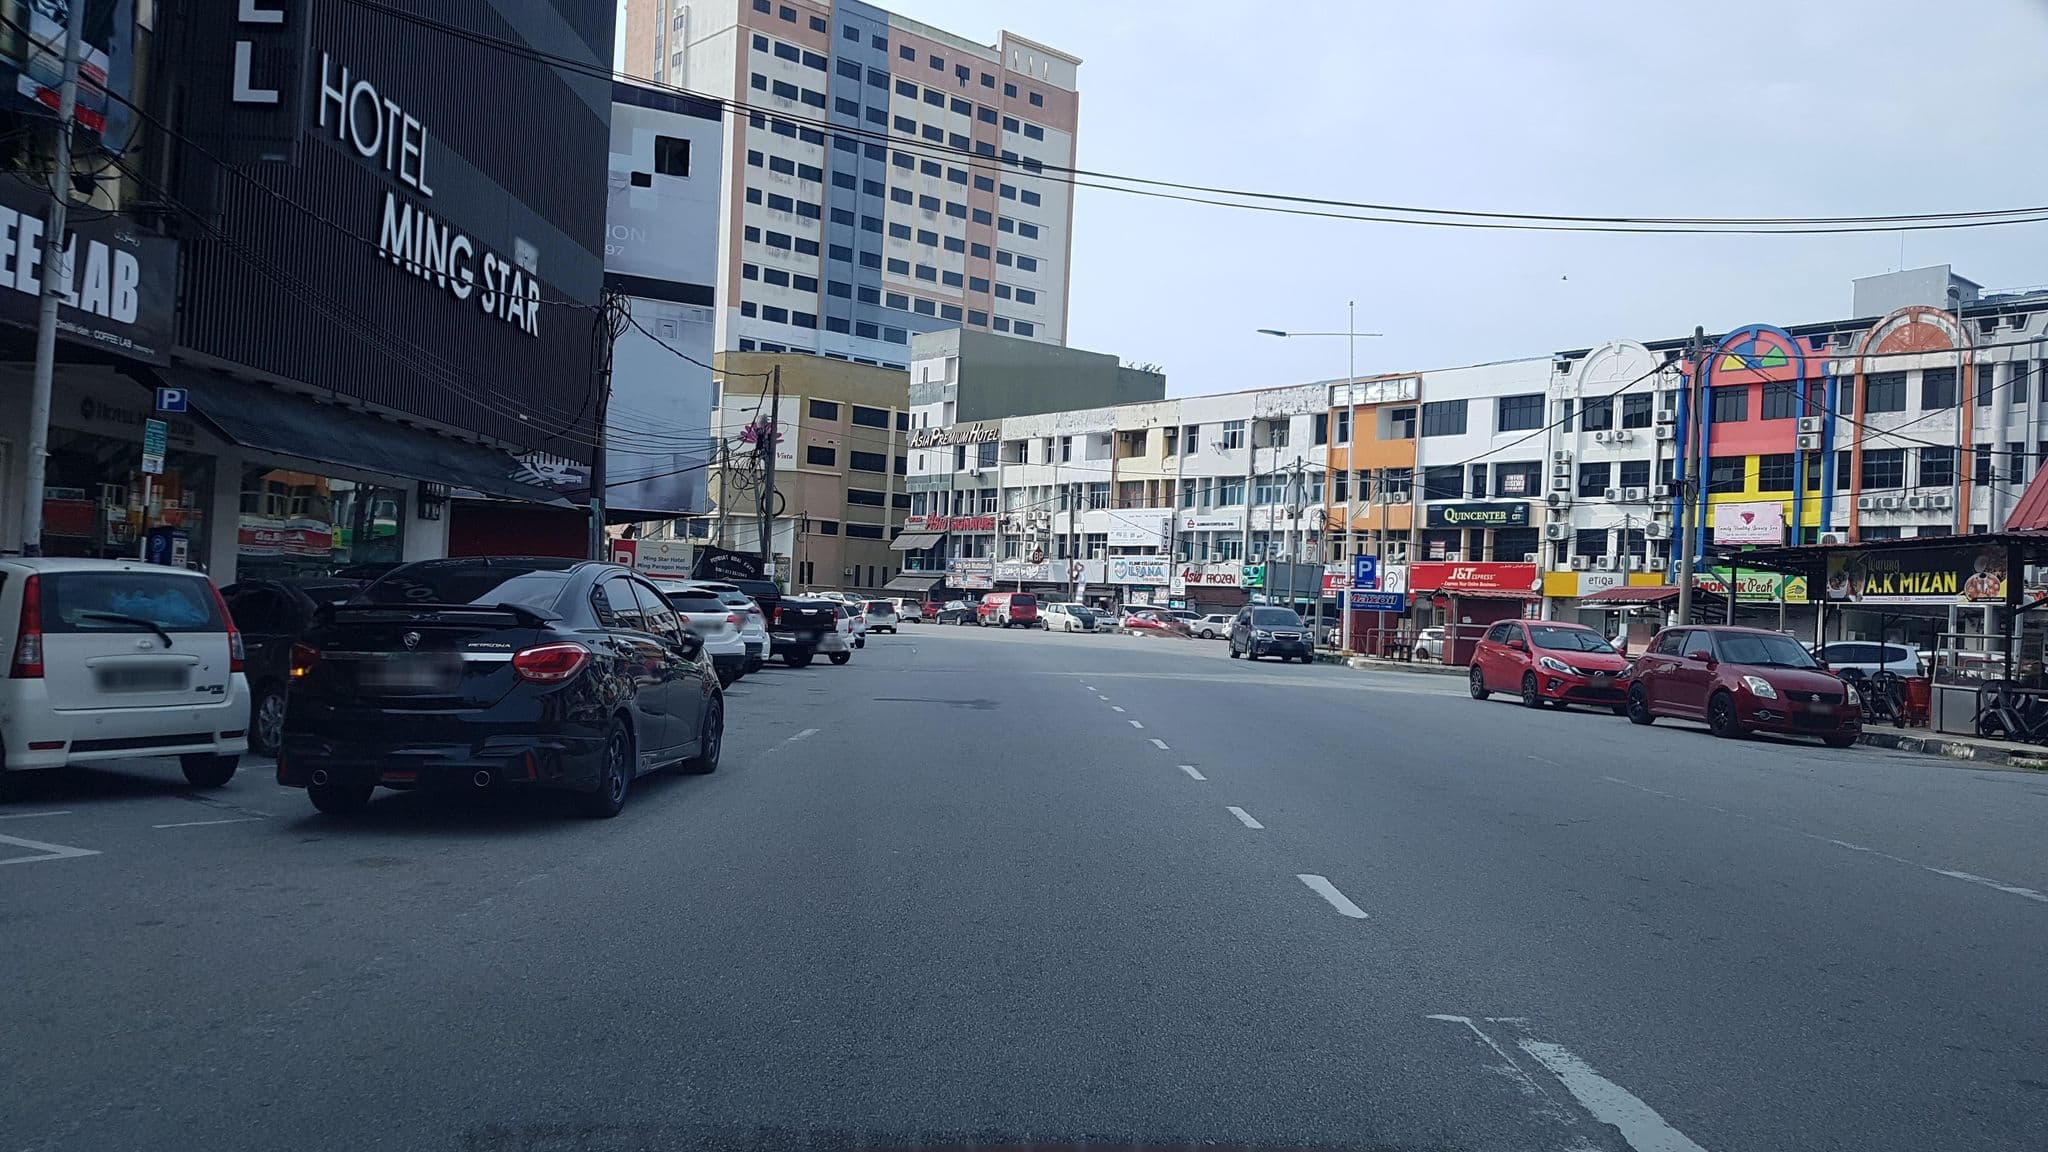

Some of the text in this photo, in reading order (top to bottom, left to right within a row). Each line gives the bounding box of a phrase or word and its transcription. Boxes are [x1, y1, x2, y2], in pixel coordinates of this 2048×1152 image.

[320, 51, 433, 197] HOTEL
[379, 191, 540, 338] MING STAR
[58, 232, 140, 325] LAB
[162, 389, 181, 409] P
[777, 452, 793, 460] Vista
[1444, 507, 1507, 524] QUINCENTER
[1181, 566, 1202, 583] Asia
[1358, 560, 1372, 578] P
[1447, 567, 1477, 580] J&T
[1899, 570, 1958, 593] MIZAN
